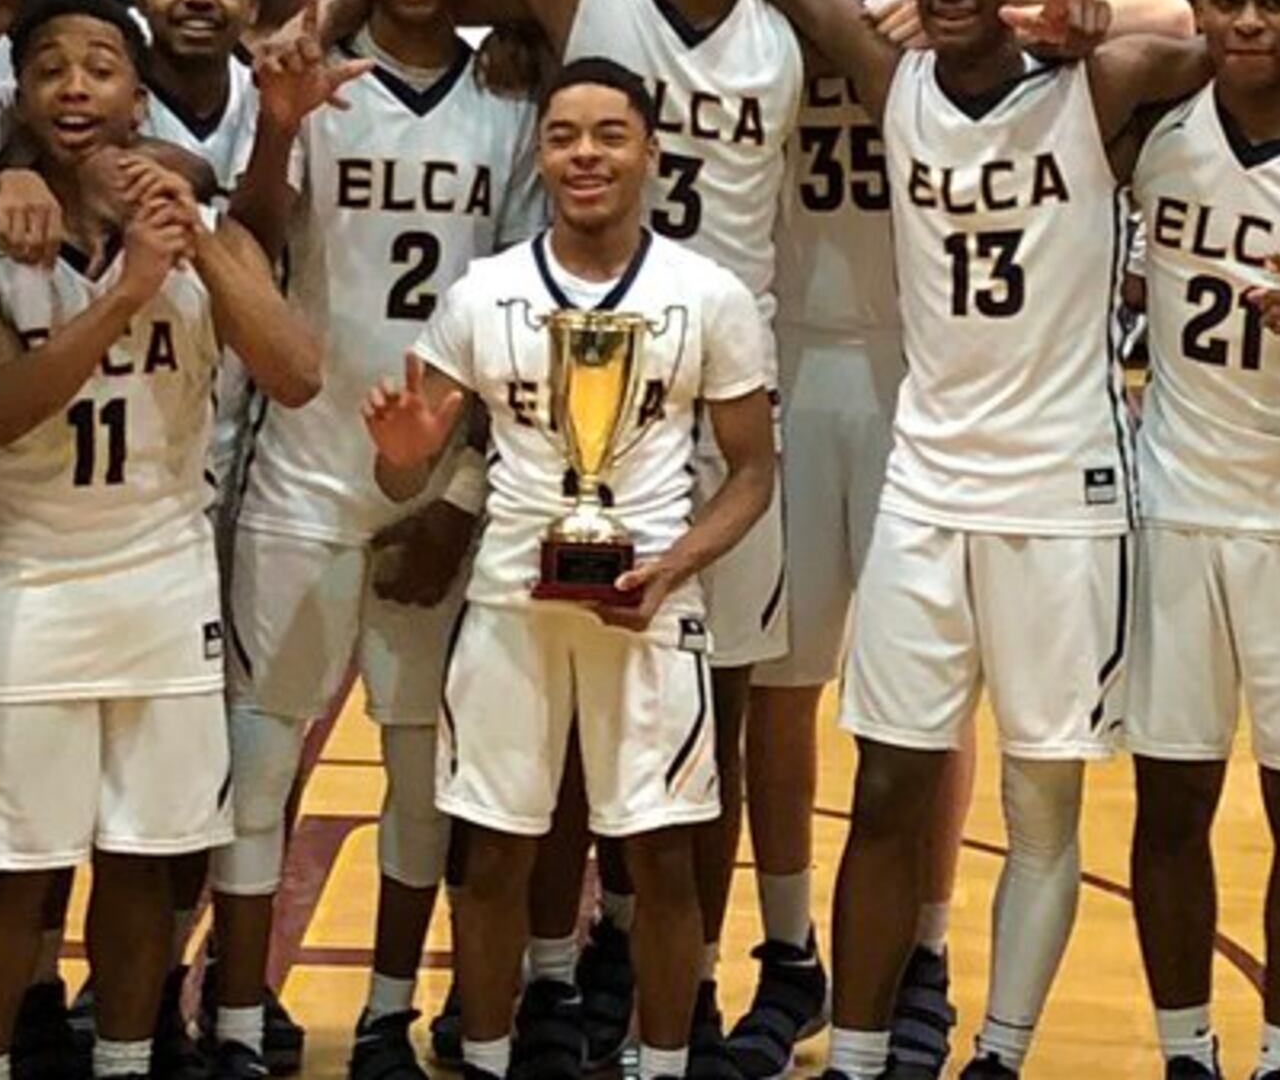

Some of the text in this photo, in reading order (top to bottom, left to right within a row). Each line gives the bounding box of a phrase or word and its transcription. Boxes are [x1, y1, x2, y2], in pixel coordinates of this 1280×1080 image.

[654, 80, 765, 146] LCA
[336, 157, 492, 217] ELCA
[650, 151, 705, 240] 3
[797, 125, 890, 212] 35
[907, 151, 1070, 215] ELCA
[386, 230, 442, 322] 2
[943, 228, 1025, 319] 13
[1181, 273, 1265, 371] 21
[66, 397, 127, 488] 11
[507, 378, 666, 432] EA
